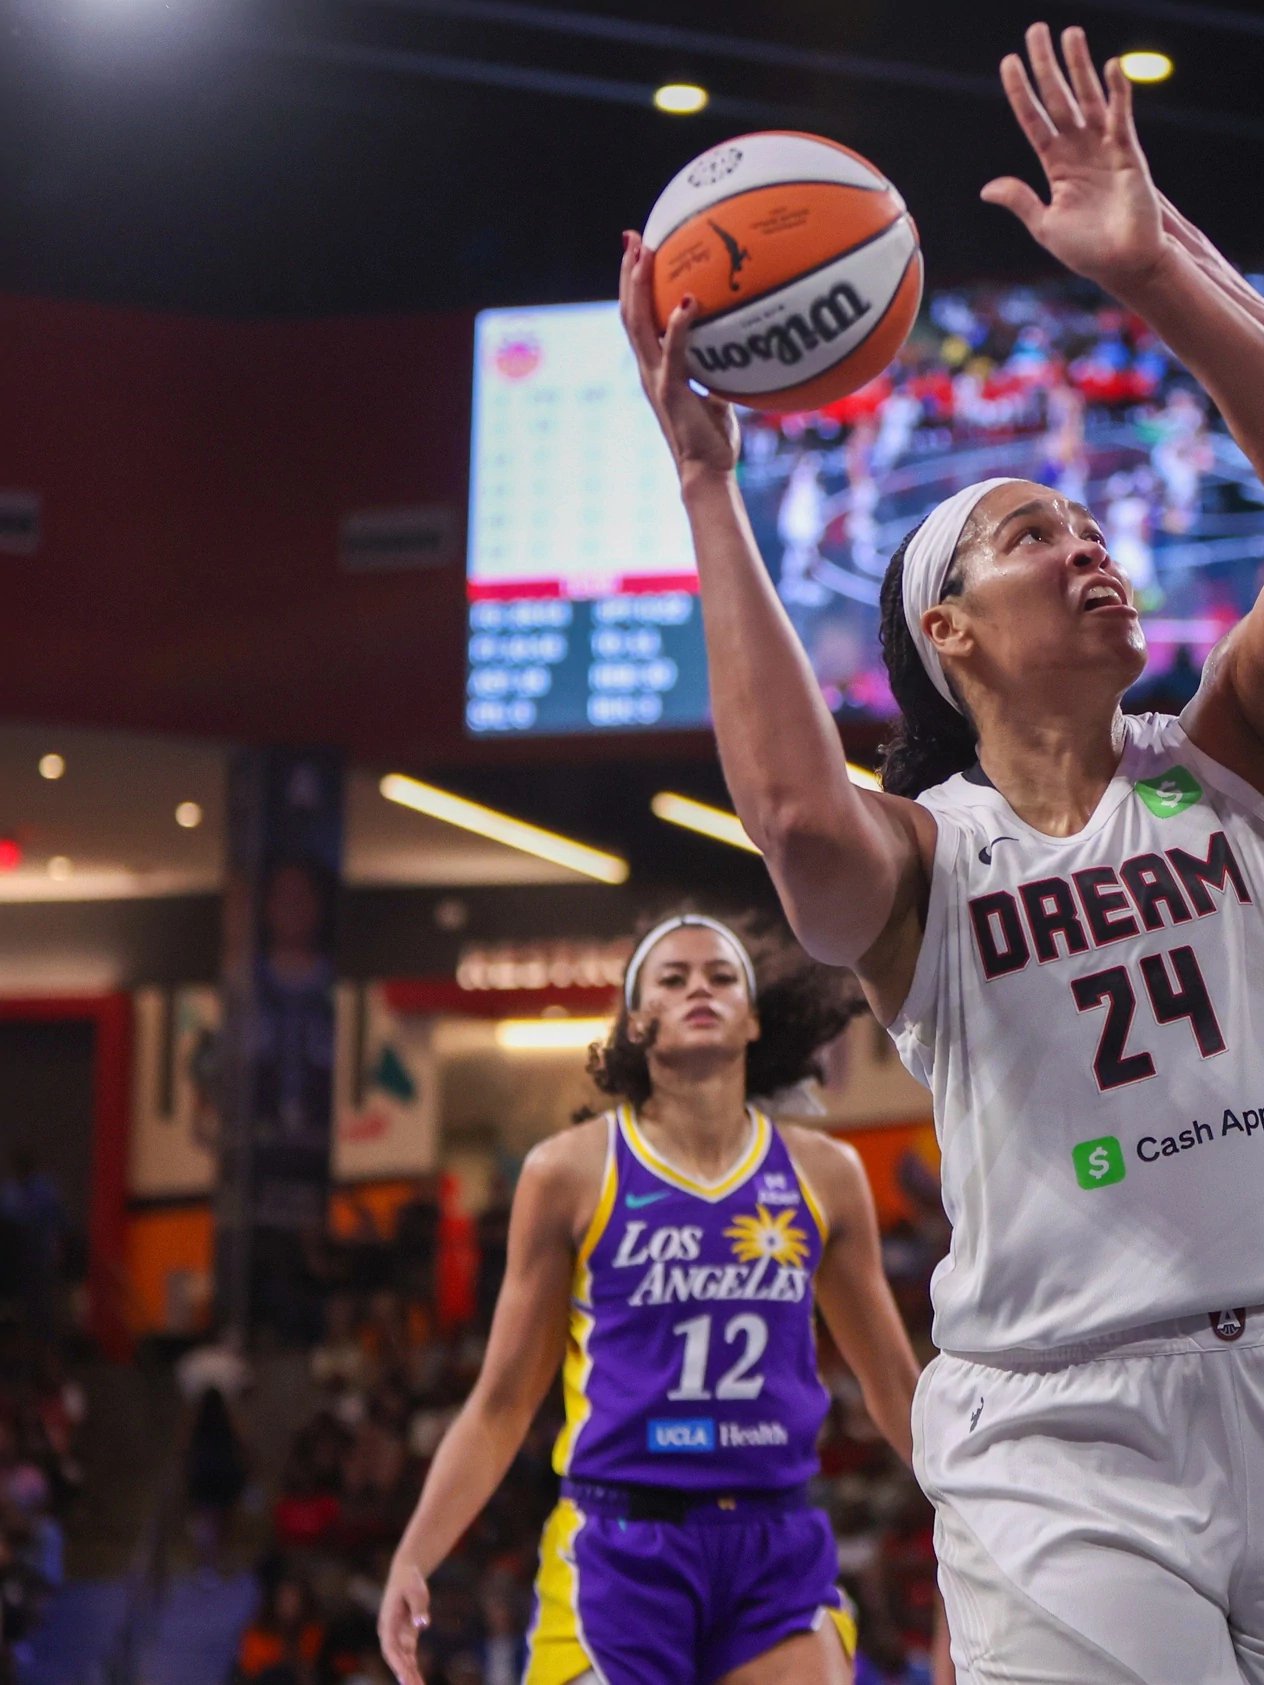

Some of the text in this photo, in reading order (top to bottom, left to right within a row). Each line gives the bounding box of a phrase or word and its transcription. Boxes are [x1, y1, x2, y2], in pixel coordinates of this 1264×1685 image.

[690, 281, 872, 373] Wilson
[968, 831, 1253, 982] DREAM
[1070, 945, 1229, 1094] 24
[1136, 1120, 1214, 1162] Cash
[612, 1219, 703, 1269] LOS
[666, 1312, 769, 1402] 12
[655, 1421, 788, 1448] UCLA Health
